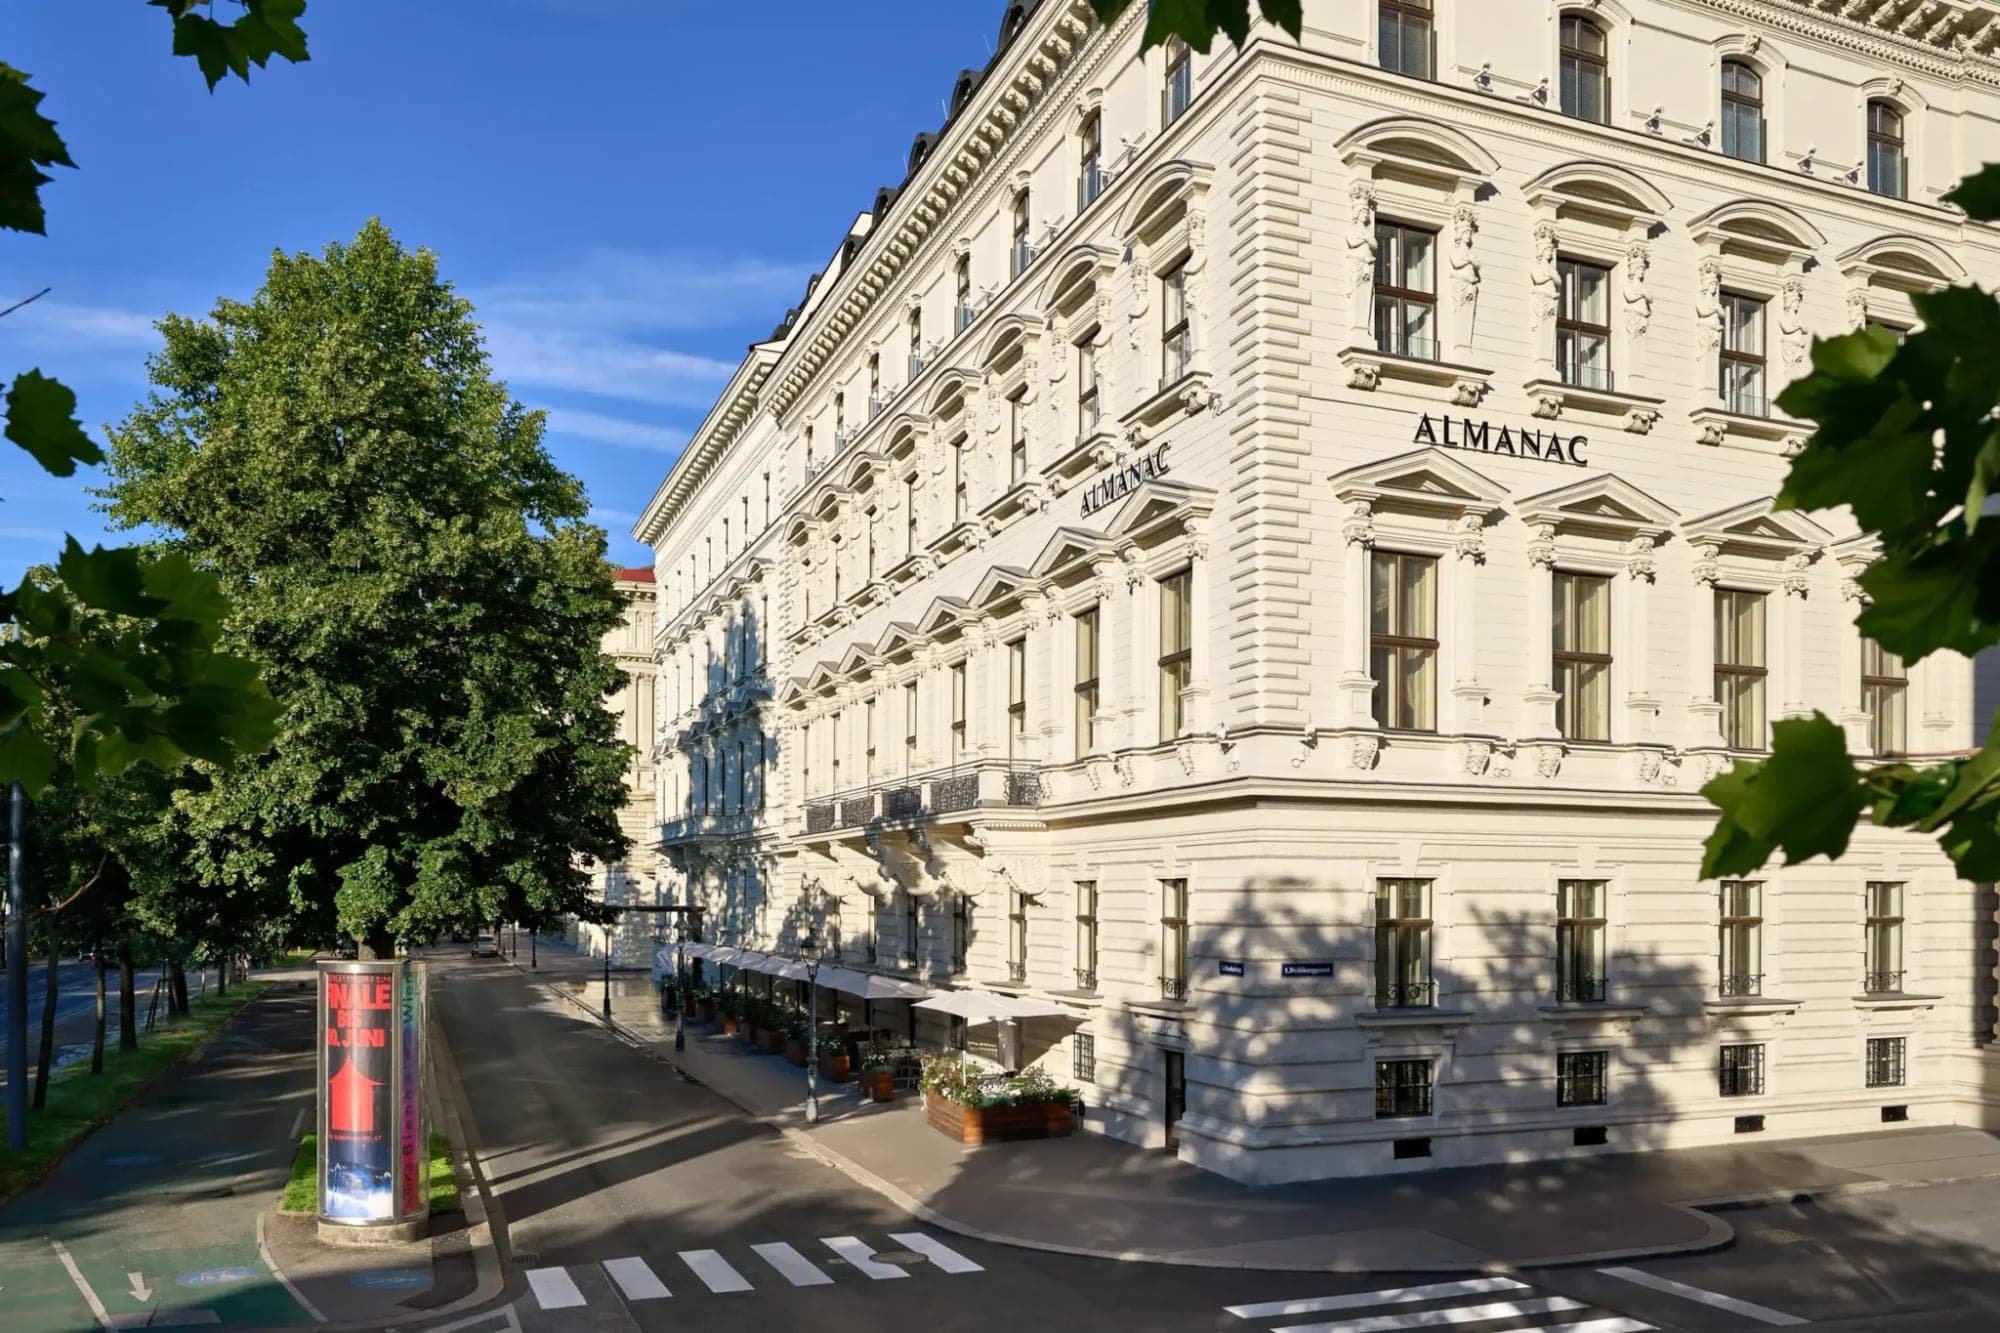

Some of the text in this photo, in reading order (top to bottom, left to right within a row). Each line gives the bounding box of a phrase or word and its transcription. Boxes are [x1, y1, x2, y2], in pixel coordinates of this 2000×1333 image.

[1414, 412, 1588, 466] ALMANAC
[1080, 442, 1171, 518] ALMANAC
[337, 1009, 363, 1028] BIS
[342, 1028, 385, 1048] JUNI
